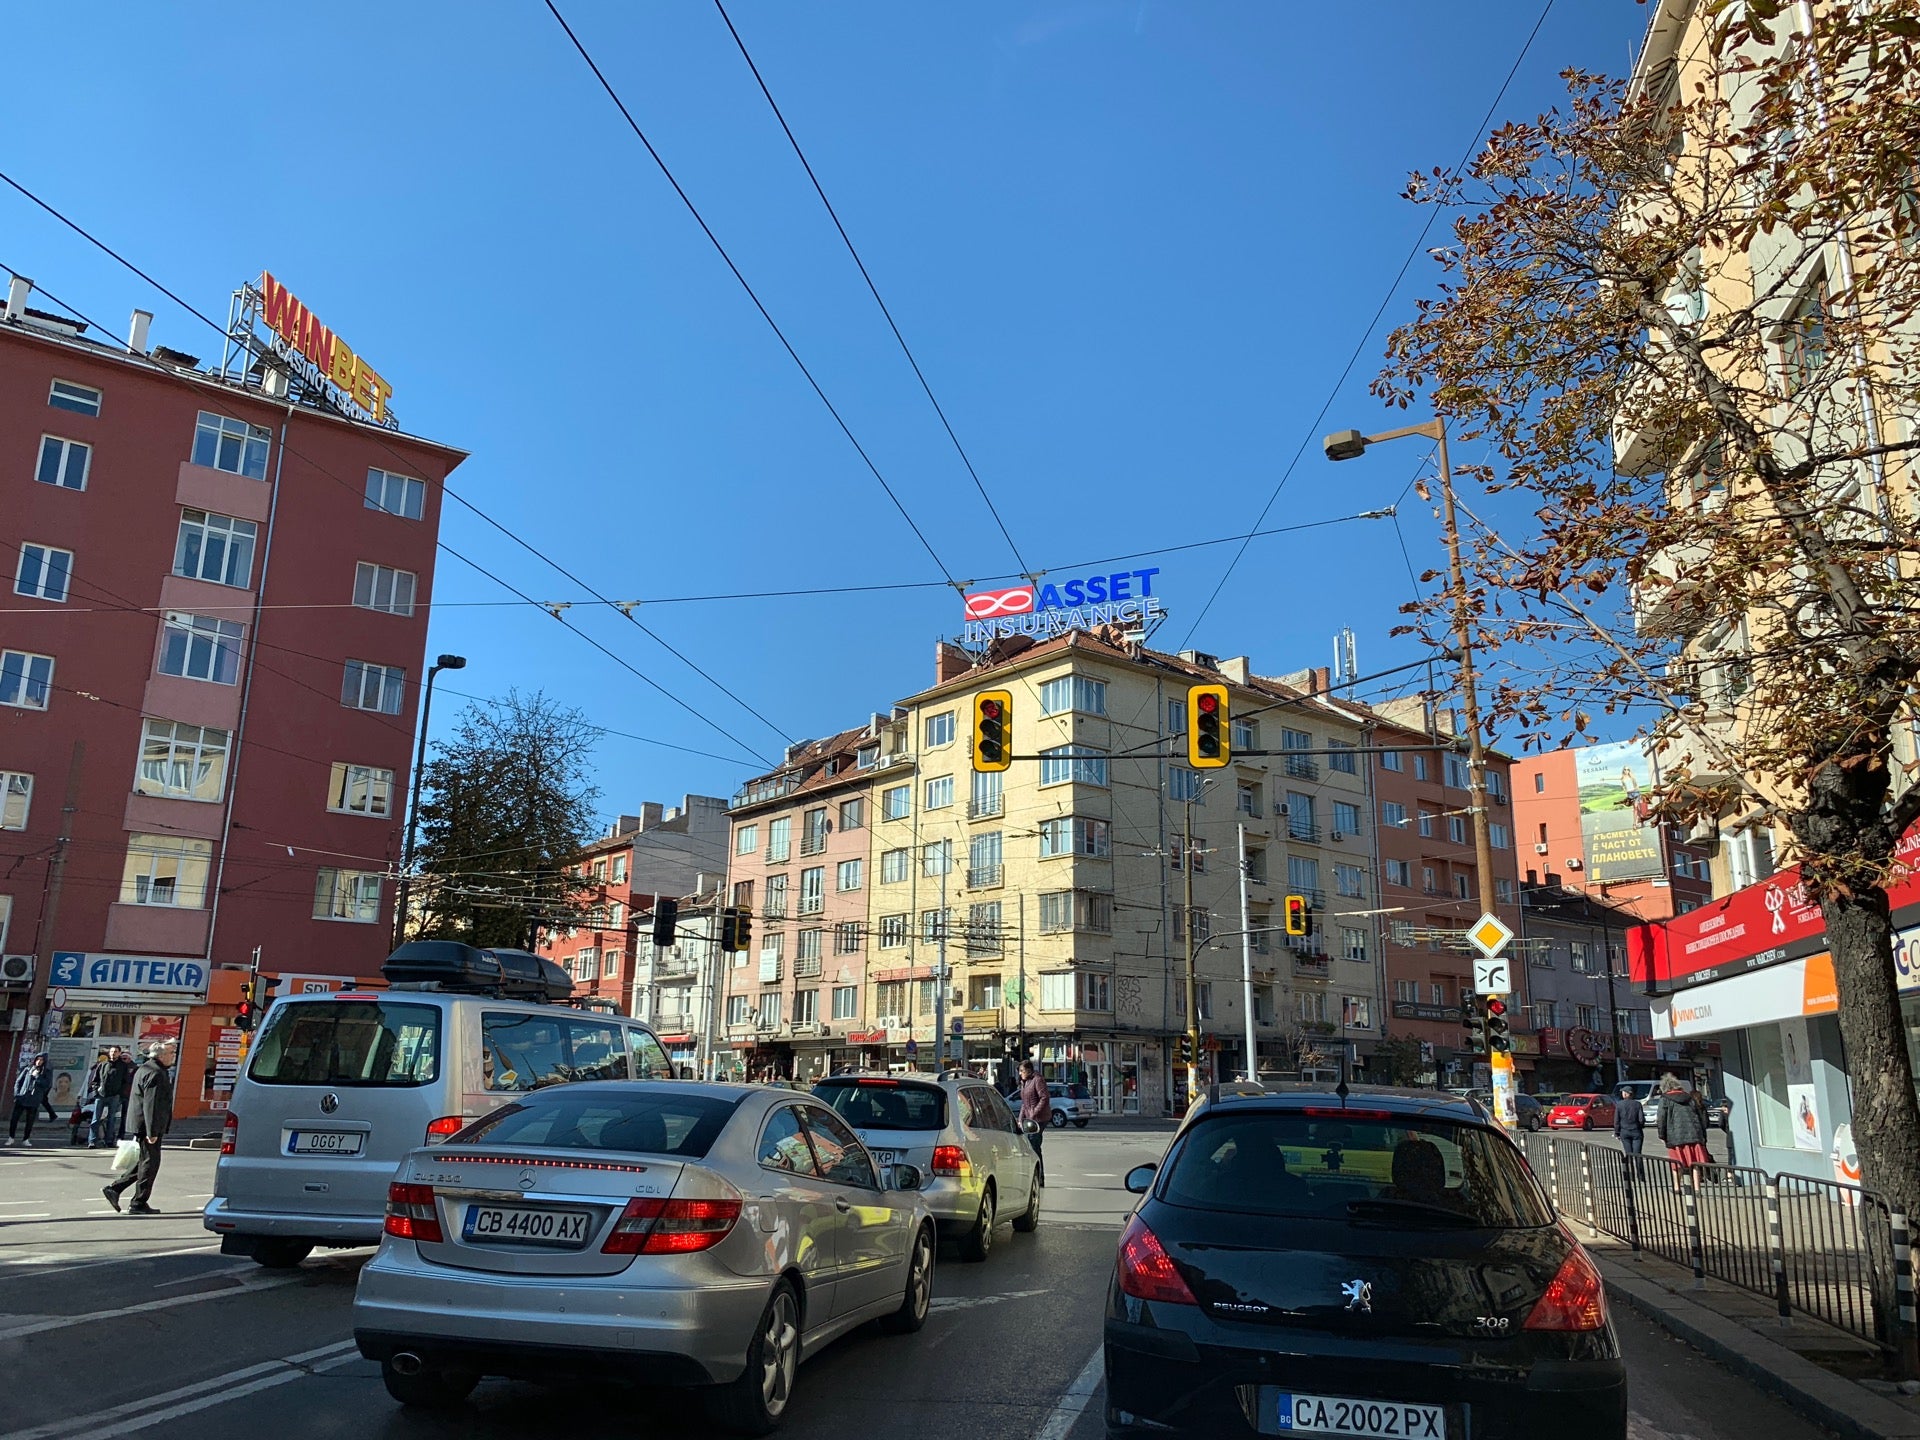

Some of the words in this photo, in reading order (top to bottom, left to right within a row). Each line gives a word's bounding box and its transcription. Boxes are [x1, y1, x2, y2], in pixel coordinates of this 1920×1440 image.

[262, 270, 393, 424] WINBET
[275, 338, 325, 393] CASINO
[1036, 567, 1160, 612] ASSET
[965, 597, 1160, 643] INSURANCE
[1593, 829, 1642, 841] КЪСМЕТЪТ
[1592, 843, 1599, 851] Е
[1601, 840, 1626, 850] ЧАСТ
[1628, 838, 1642, 847] ОТ
[1592, 847, 1657, 864] ПЛАНОВЕТЕ
[90, 959, 203, 988] АПТЕКА
[305, 983, 328, 994] SDI
[1678, 1004, 1713, 1023] VIVACOM
[311, 1134, 345, 1149] OGGY
[635, 1184, 662, 1194] CDI
[477, 1210, 503, 1233] CB
[505, 1212, 553, 1236] 4400
[557, 1216, 585, 1239] AX
[1213, 1302, 1270, 1314] PEUGEOT
[1474, 1316, 1509, 1330] 308
[1280, 1414, 1292, 1425] BG
